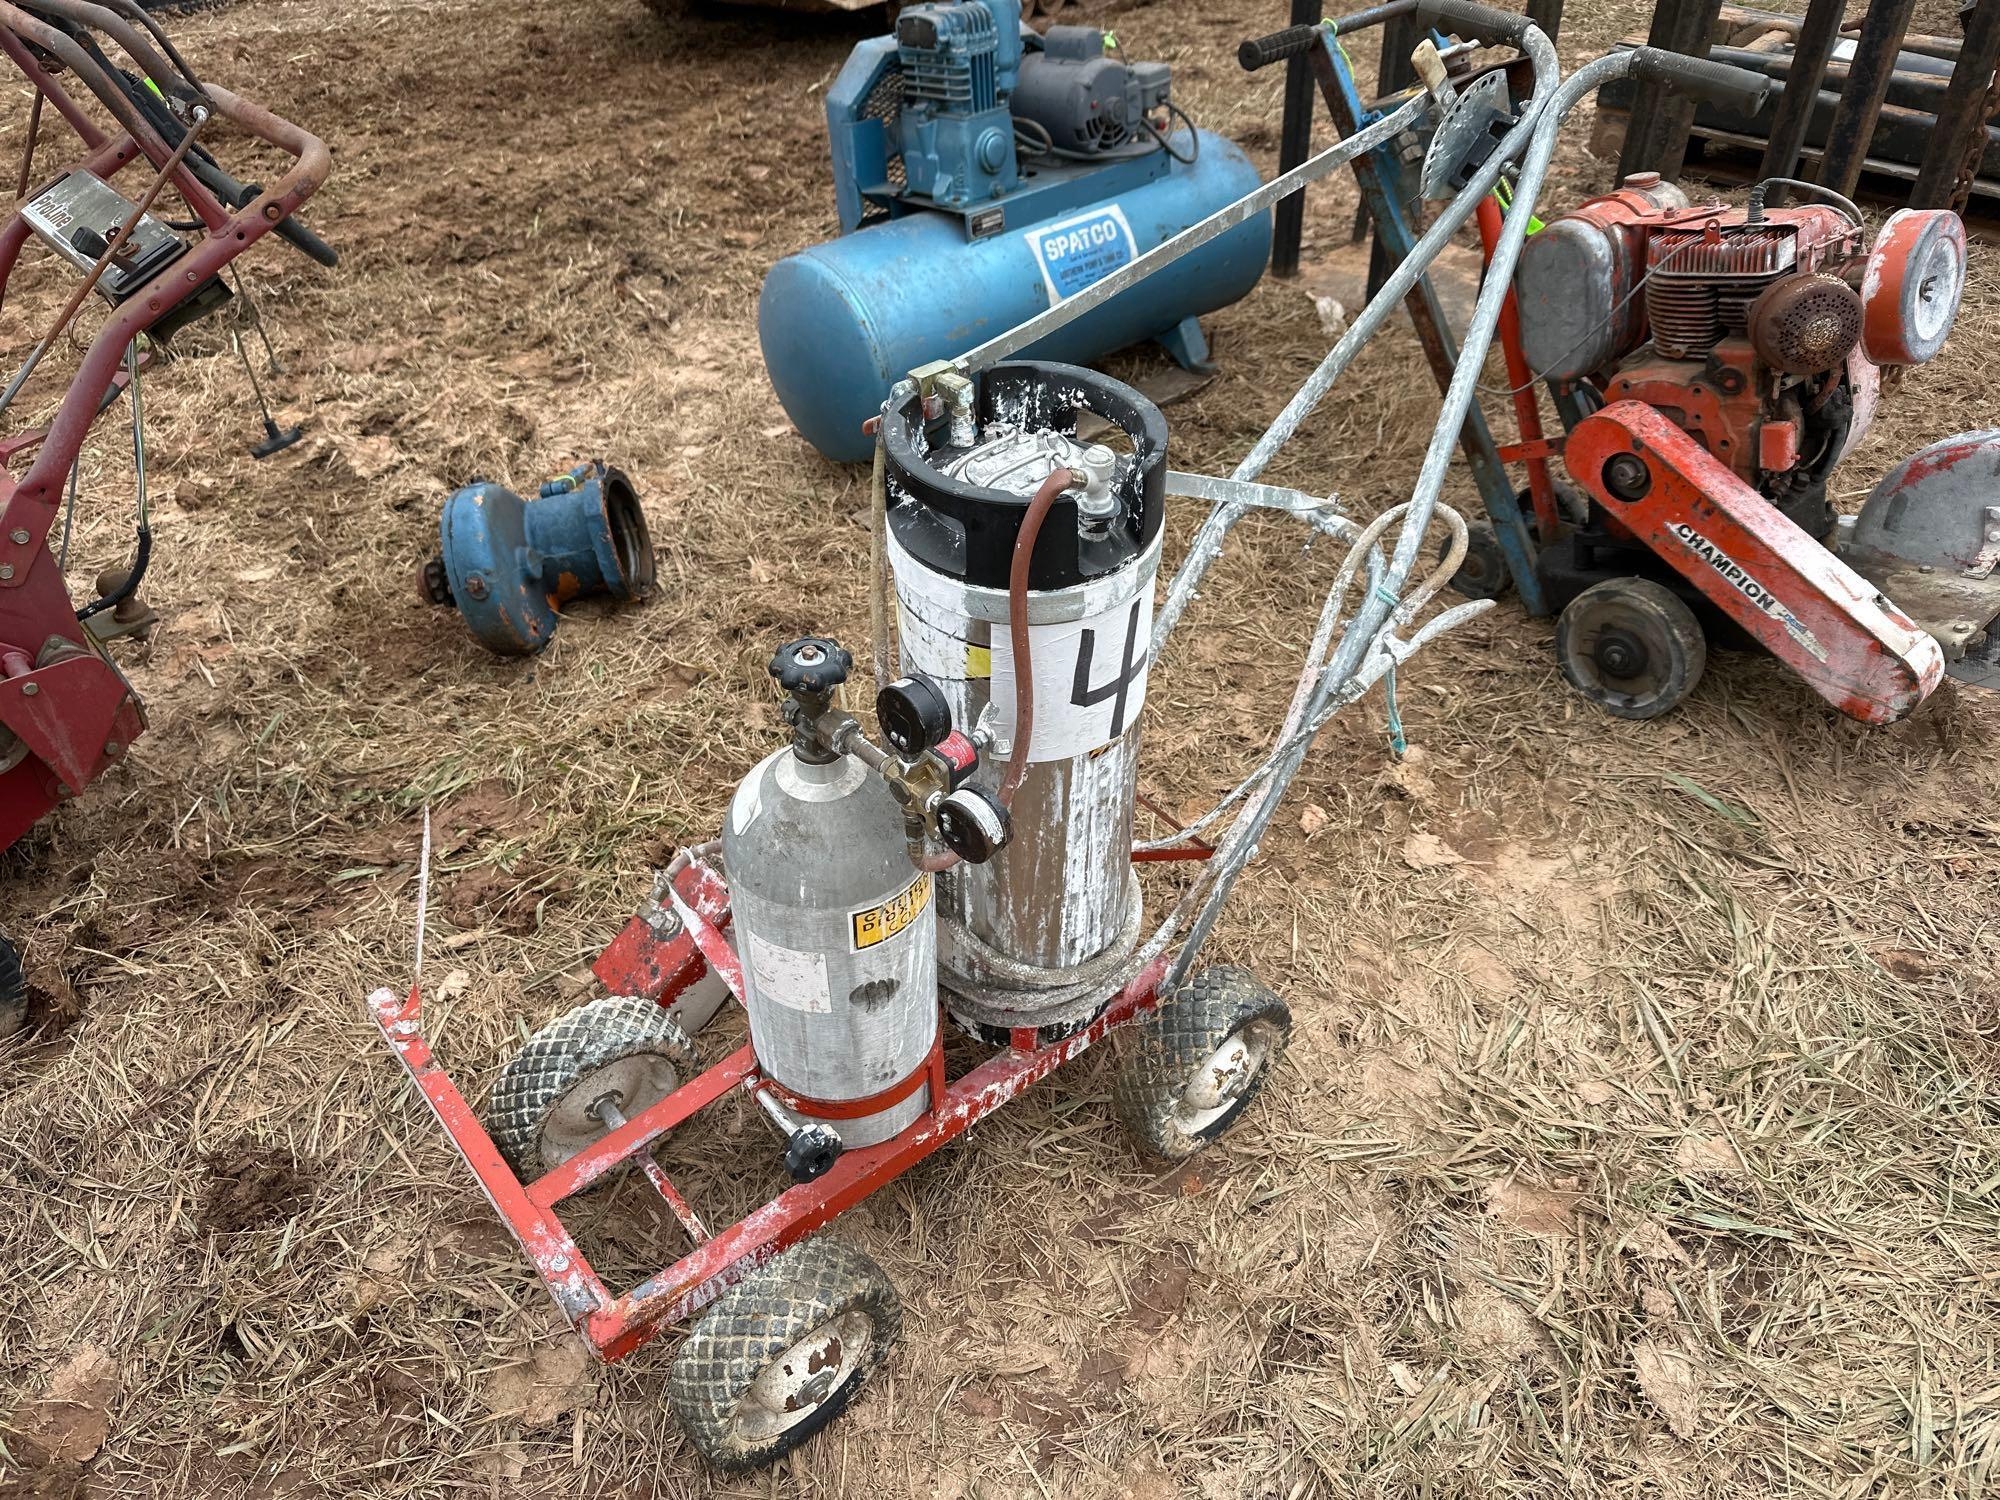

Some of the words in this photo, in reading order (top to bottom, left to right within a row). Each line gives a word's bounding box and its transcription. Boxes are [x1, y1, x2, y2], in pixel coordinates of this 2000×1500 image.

[31, 195, 72, 228] ProLine
[1045, 219, 1117, 261] SPATCO
[1678, 524, 1775, 610] CHAMPION
[1070, 598, 1148, 739] 4
